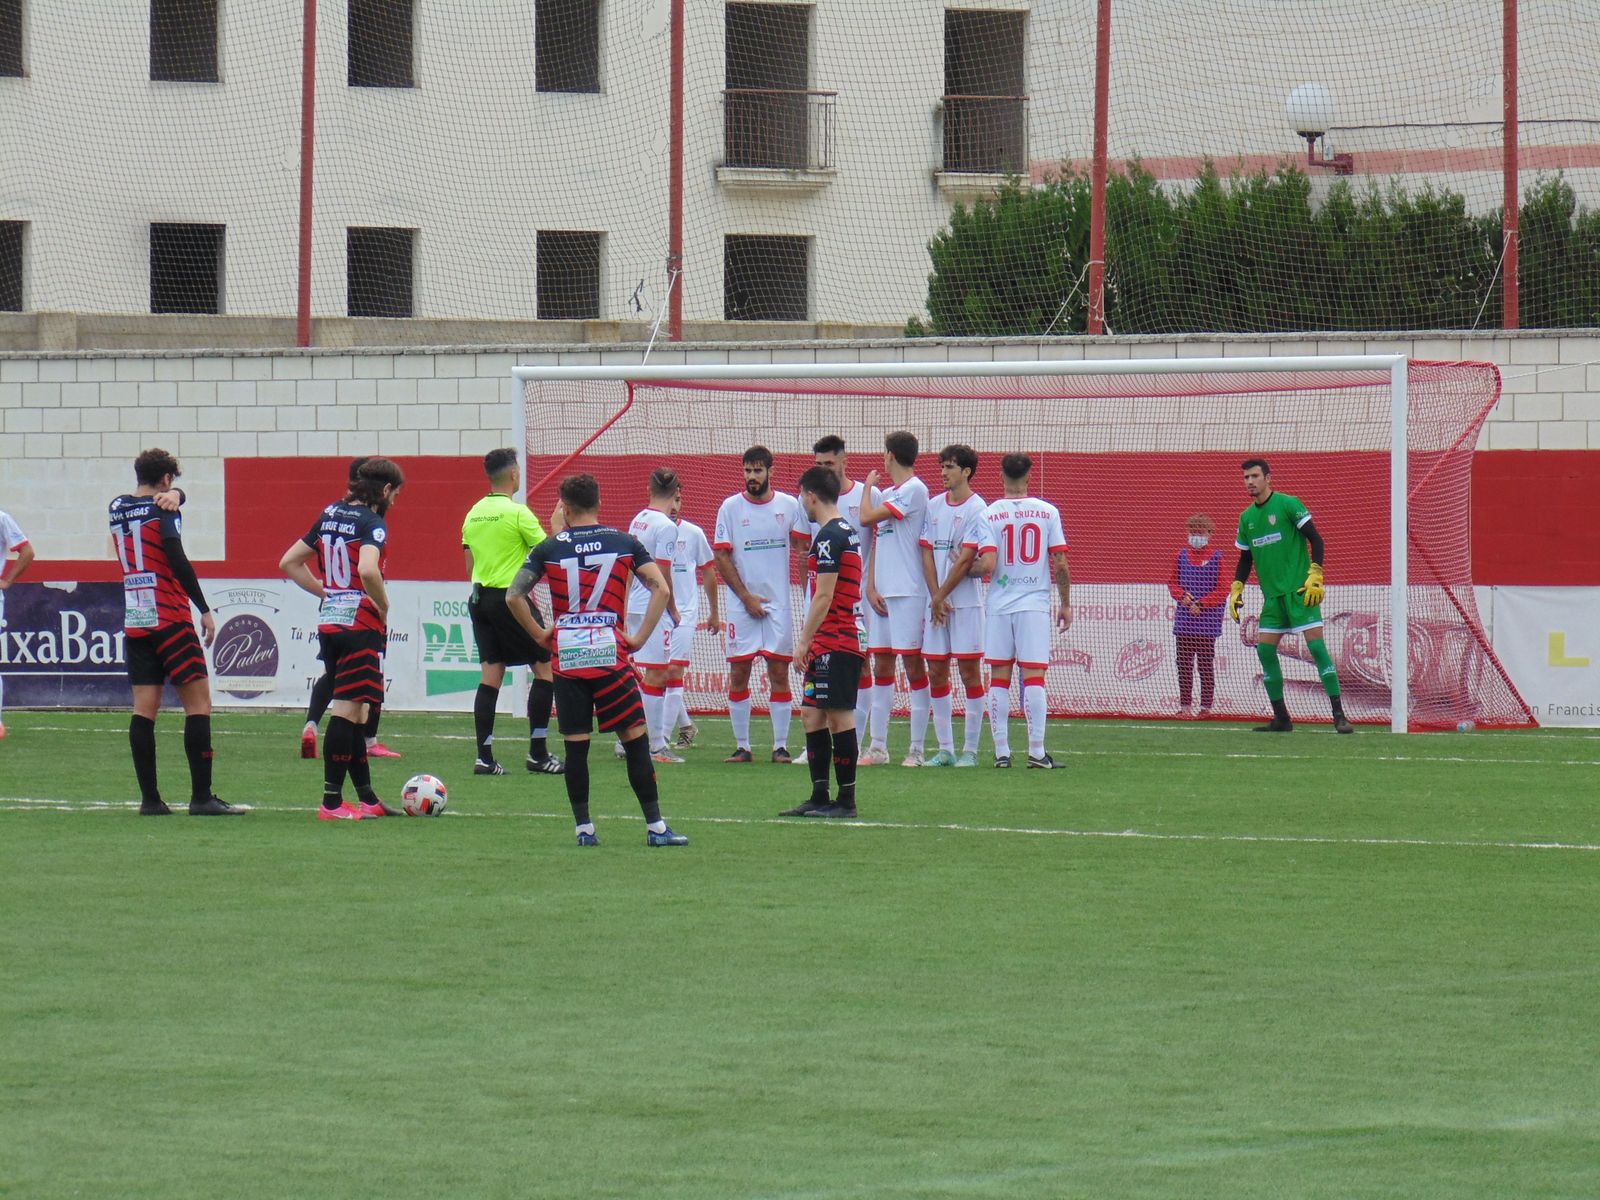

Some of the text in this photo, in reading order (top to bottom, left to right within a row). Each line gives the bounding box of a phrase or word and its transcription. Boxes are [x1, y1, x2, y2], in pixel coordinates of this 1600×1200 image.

[111, 519, 145, 573] 11
[322, 533, 352, 589] 10
[574, 541, 602, 553] GATO
[1001, 522, 1041, 566] 10
[559, 553, 618, 613] 17
[433, 600, 470, 617] ROSQ
[291, 627, 303, 640] Tú
[728, 622, 736, 640] 8
[1548, 631, 1589, 668] L
